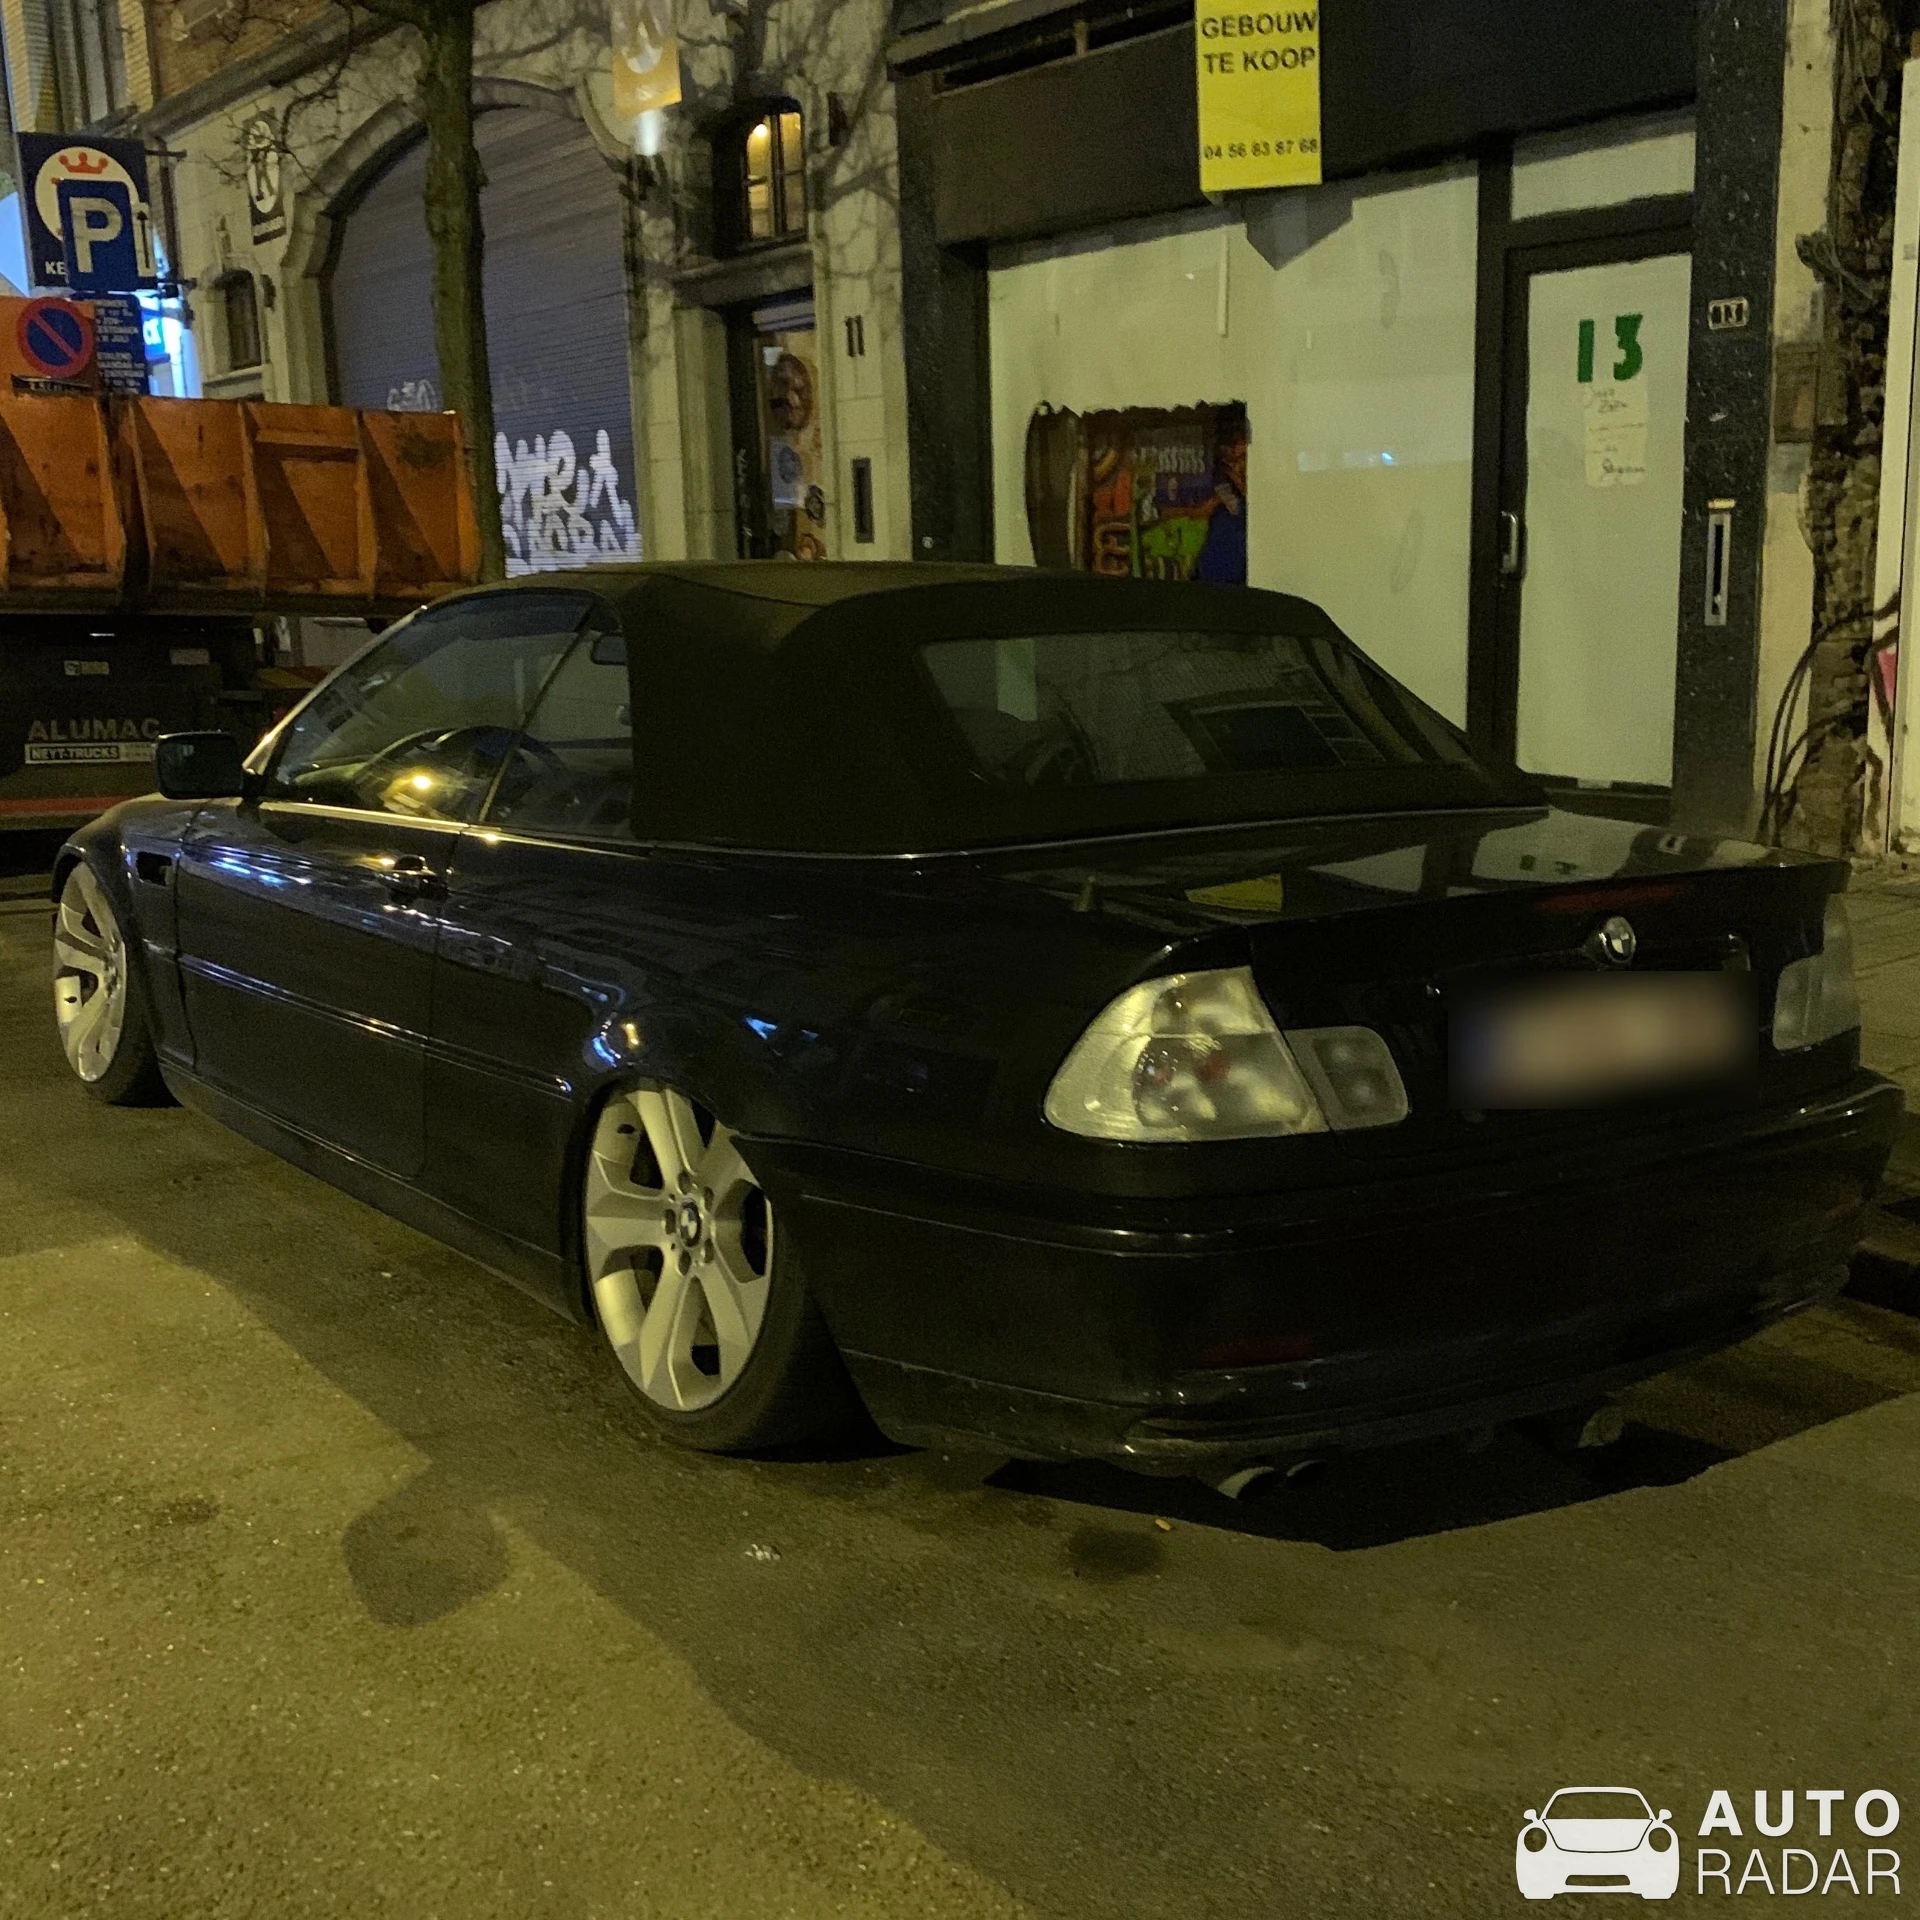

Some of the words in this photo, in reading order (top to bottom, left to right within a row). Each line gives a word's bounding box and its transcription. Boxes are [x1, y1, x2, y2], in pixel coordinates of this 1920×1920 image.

[1201, 12, 1317, 39] GEBOUW
[1204, 52, 1235, 74] TE
[1243, 47, 1316, 72] KOOP
[1203, 144, 1223, 160] 04
[69, 197, 123, 273] P
[1577, 313, 1643, 383] 13
[28, 718, 160, 741] ALUMAC
